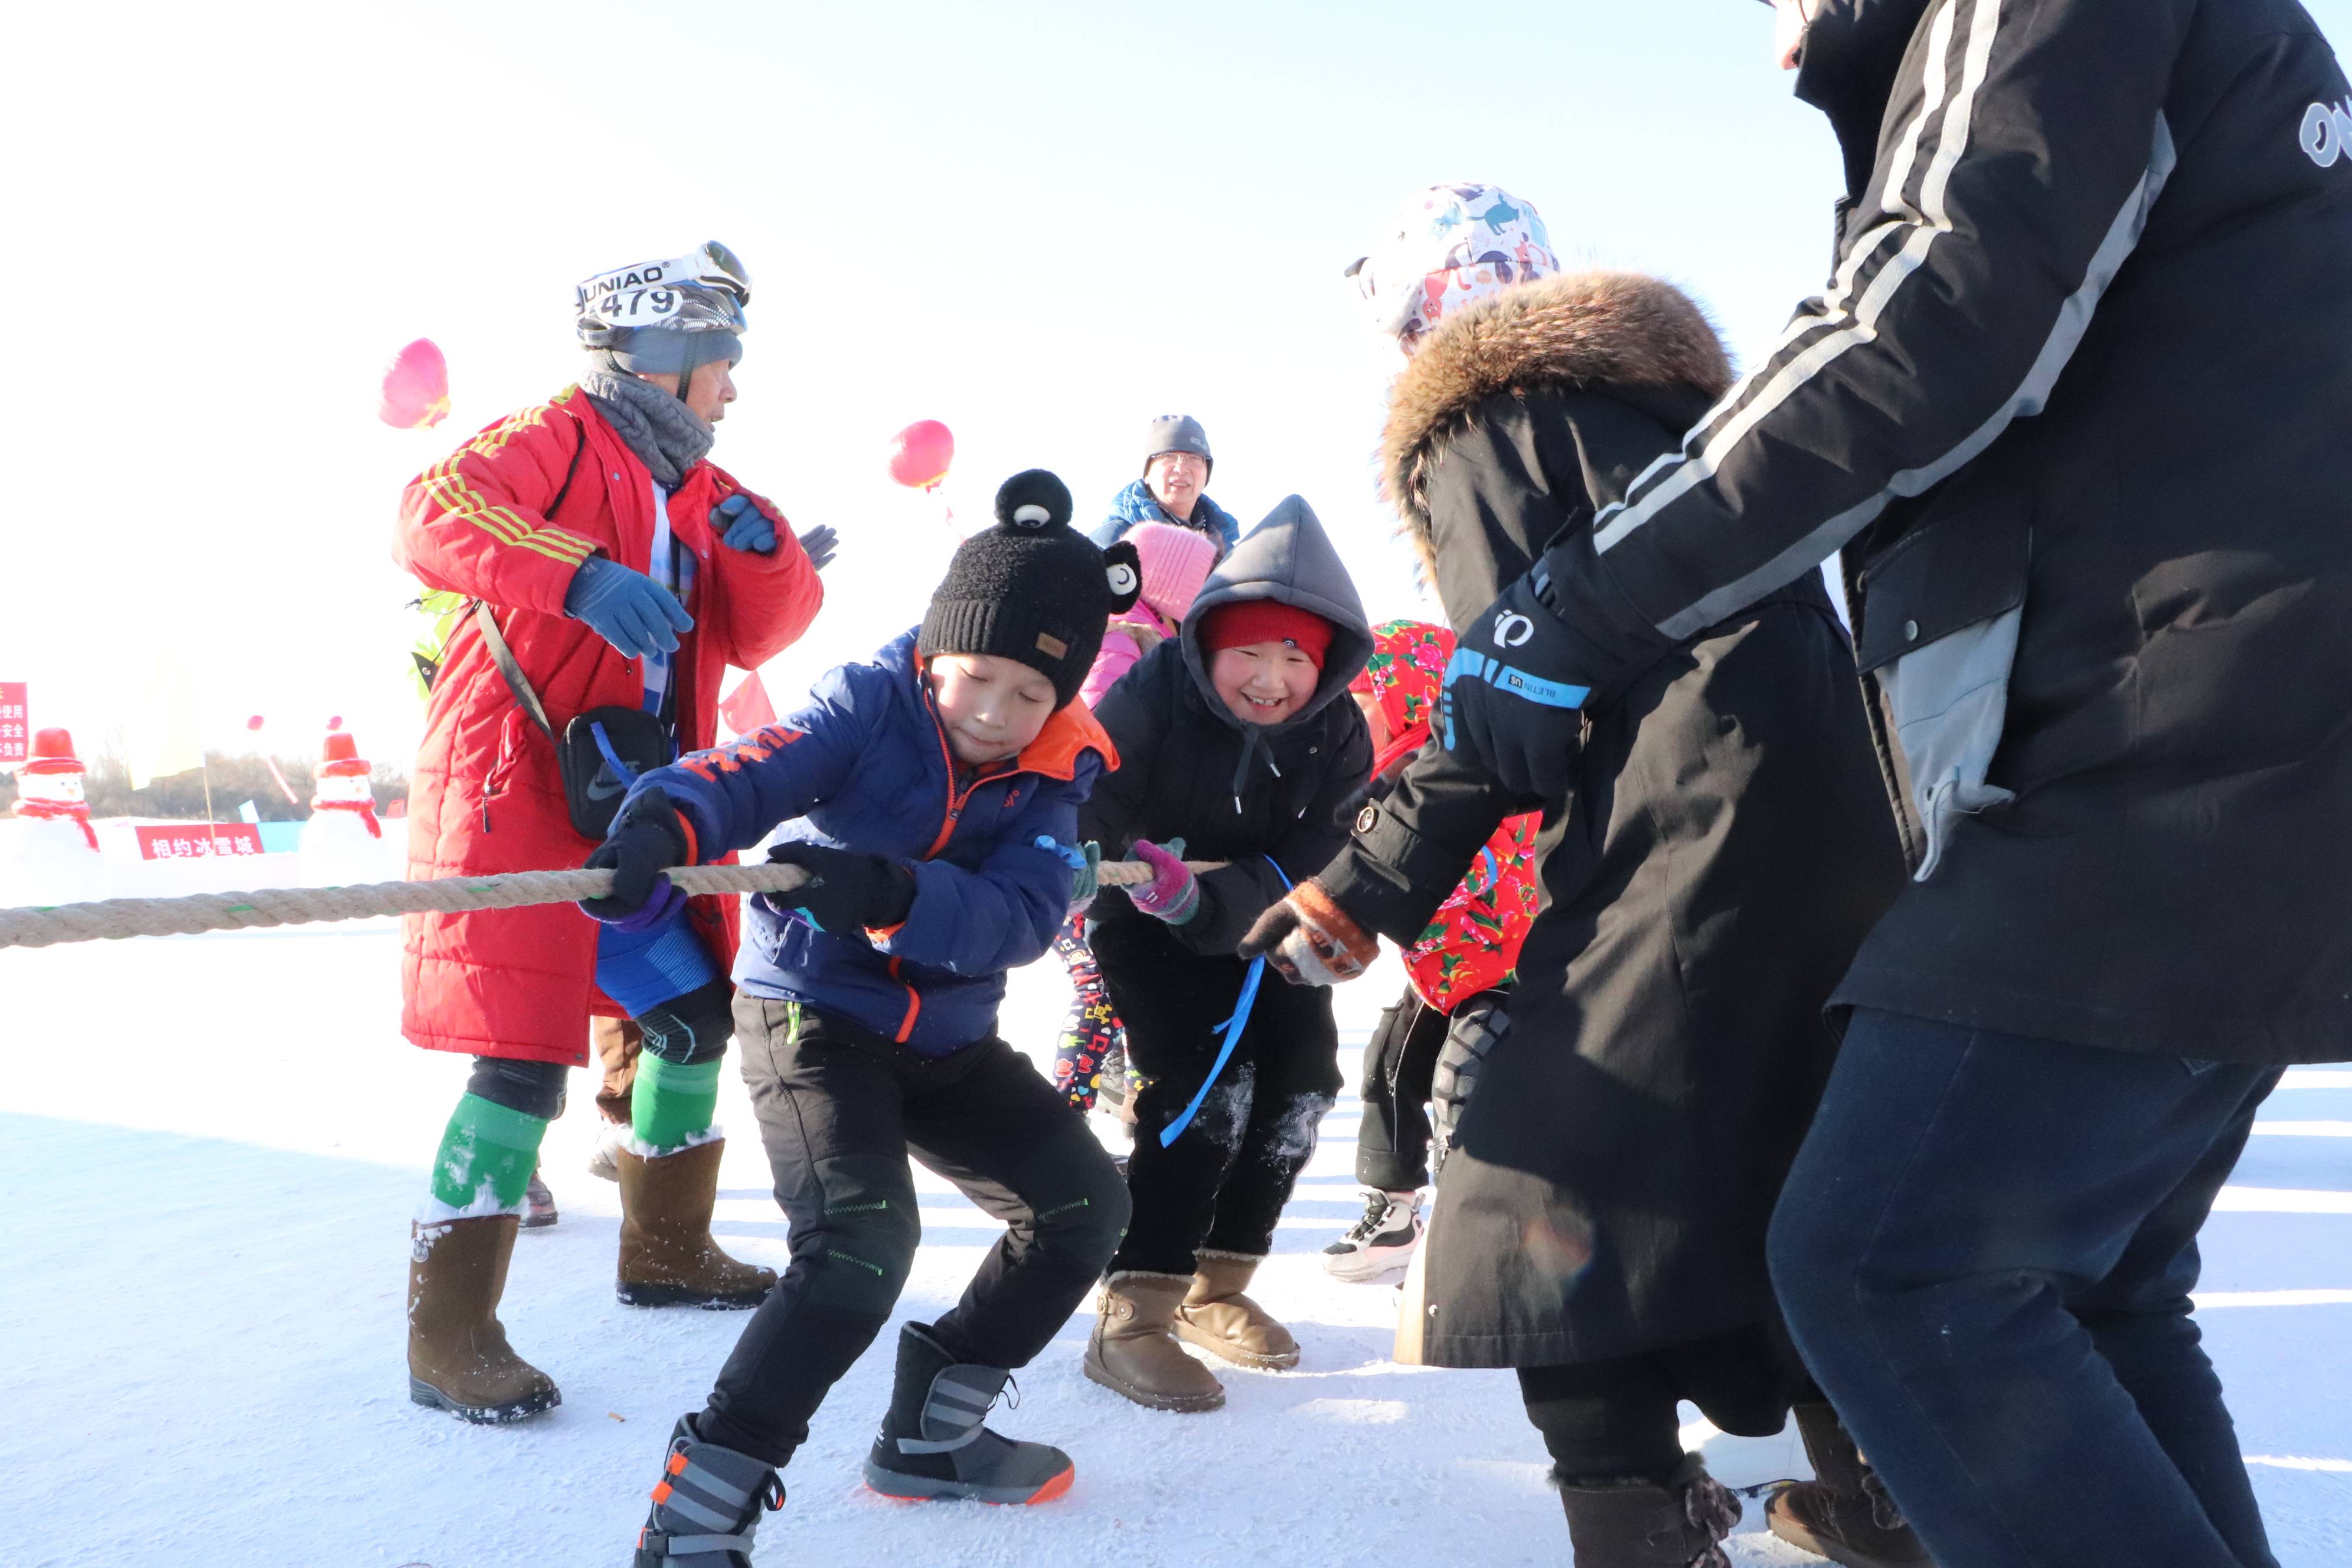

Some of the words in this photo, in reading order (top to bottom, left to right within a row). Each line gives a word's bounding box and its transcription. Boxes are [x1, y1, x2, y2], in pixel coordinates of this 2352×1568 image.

[601, 289, 674, 317] 479
[1511, 675, 1521, 687] US
[0, 705, 22, 718] 使用
[0, 723, 24, 737] 安全
[0, 742, 24, 756] 负责
[152, 836, 254, 858] 相约冰雪城
